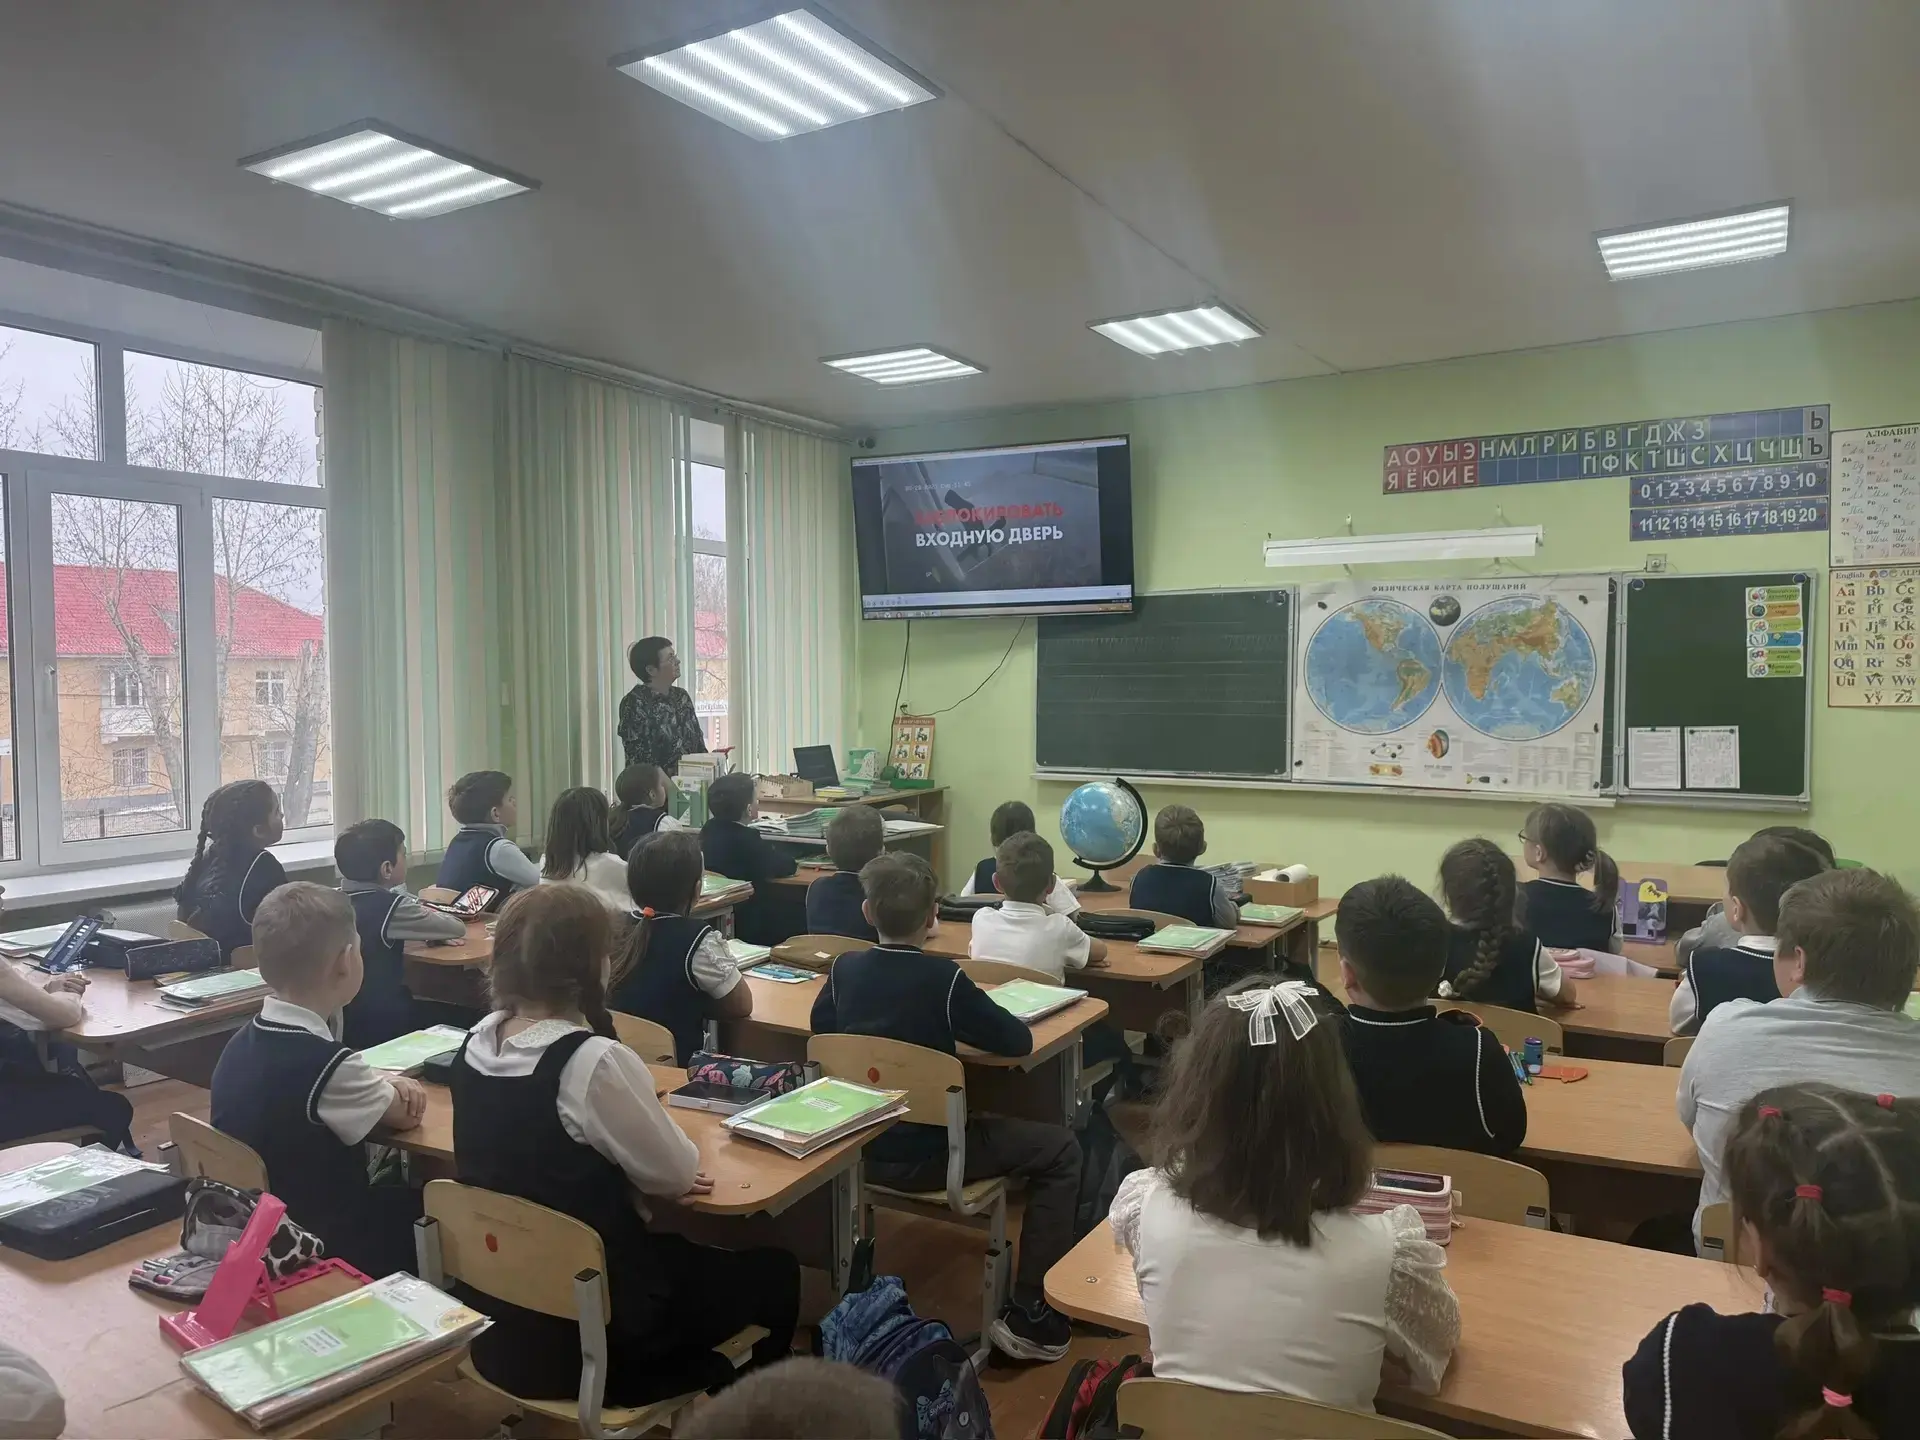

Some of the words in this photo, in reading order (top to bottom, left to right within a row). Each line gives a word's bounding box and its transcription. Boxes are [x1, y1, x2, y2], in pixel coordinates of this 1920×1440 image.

[1866, 426, 1919, 438] АЛФАВИТ
[1387, 454, 1400, 467] А
[1405, 450, 1421, 465] О
[1426, 448, 1438, 463] У
[1443, 446, 1458, 462] Ы
[1463, 443, 1475, 460] Э
[1482, 441, 1495, 458] Н
[1499, 440, 1516, 456] М
[1521, 438, 1534, 455] Л
[1544, 436, 1554, 454] Р
[1562, 433, 1577, 452] Й
[1585, 432, 1596, 449] Б
[1605, 429, 1616, 448] В
[1627, 427, 1638, 446] Г
[1645, 425, 1661, 446] Д
[1666, 423, 1685, 443] Ж
[1692, 422, 1704, 440] З
[1811, 411, 1823, 430] Ь
[1388, 472, 1398, 490] Я
[1407, 467, 1417, 488] Ё
[1423, 469, 1439, 487] Ю
[1443, 467, 1456, 485] И
[1464, 465, 1474, 484] Е
[1583, 455, 1596, 474] П
[1602, 453, 1619, 473] Ф
[1626, 451, 1638, 471] К
[1648, 450, 1660, 469] Т
[1667, 448, 1685, 467] Ш
[1691, 446, 1705, 465] С
[1713, 444, 1728, 463] Х
[1736, 442, 1752, 463] Ц
[1761, 441, 1774, 459] Ч
[1781, 438, 1802, 459] Щ
[1808, 437, 1823, 455] Ъ
[1641, 484, 1650, 499] 0
[1656, 483, 1663, 498] 1
[1669, 482, 1680, 497] 2
[1685, 481, 1695, 496] 3
[1700, 479, 1711, 494] 4
[1716, 478, 1727, 494] 5
[1732, 477, 1743, 492] 6
[1748, 476, 1758, 492] 7
[1764, 475, 1774, 491] 8
[1780, 474, 1791, 489] 9
[1796, 472, 1817, 488] 10
[1640, 518, 1653, 532] 11
[1655, 517, 1671, 531] 12
[1672, 516, 1688, 530] 13
[1690, 514, 1706, 529] 14
[1708, 513, 1723, 528] 15
[1726, 512, 1741, 527] 16
[1744, 510, 1760, 526] 17
[1762, 509, 1778, 525] 18
[1780, 508, 1797, 524] 19
[1799, 507, 1817, 523] 20
[915, 528, 1005, 548] ВХОДНУЮ
[1008, 525, 1064, 544] ДВЕРЬ
[1836, 571, 1865, 580] English
[1467, 583, 1527, 591] ПОЛУШАРИЙ
[1836, 587, 1855, 597] Aa
[1866, 586, 1885, 596] Bb
[1896, 584, 1915, 595] Cc
[1837, 605, 1855, 615] Ee
[1867, 603, 1883, 614] Ff
[1893, 603, 1914, 615] Gg
[1839, 622, 1849, 632] Ii
[1865, 621, 1878, 634] Jj
[1894, 620, 1915, 631] Kk
[1834, 640, 1858, 651] Mm
[1865, 640, 1885, 650] Nn
[1893, 638, 1914, 649] Oo
[1834, 657, 1854, 670] Qq
[1866, 658, 1884, 668] Rr
[1896, 657, 1912, 668] Ss
[1836, 676, 1855, 686] Uu
[1866, 675, 1884, 686] Vv
[1892, 675, 1917, 686] Ww
[1864, 693, 1883, 704] Yy
[1895, 693, 1913, 703] Zz
